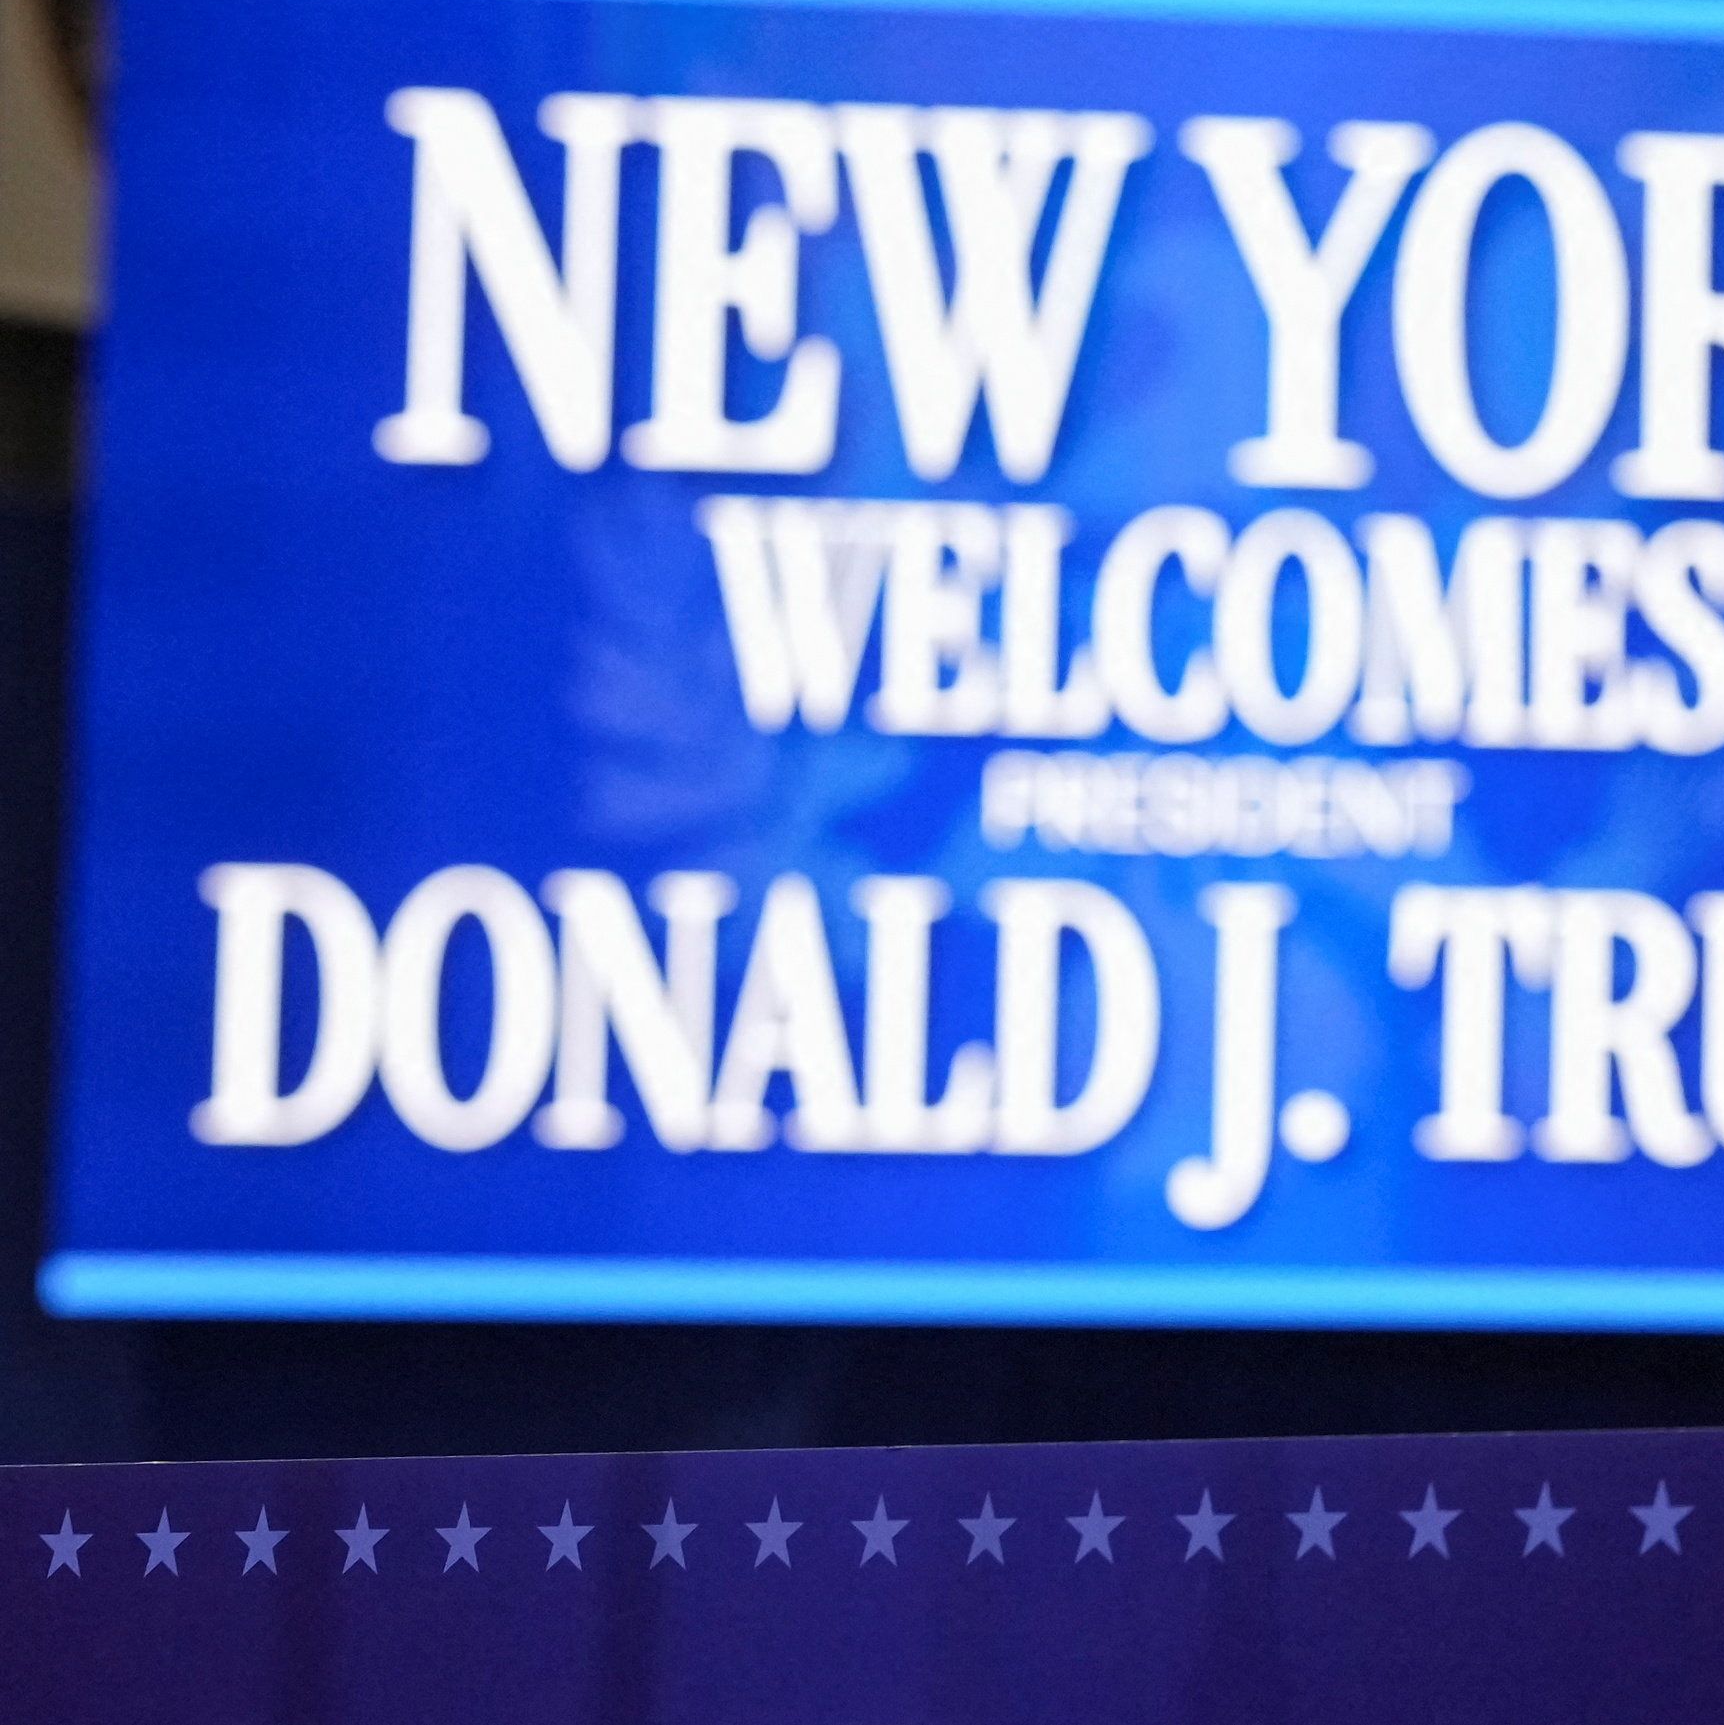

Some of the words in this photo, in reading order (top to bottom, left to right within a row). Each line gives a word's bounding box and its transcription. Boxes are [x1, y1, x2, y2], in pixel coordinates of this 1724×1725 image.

[376, 84, 1154, 482] NEW
[193, 861, 1162, 1155] DONALD
[1167, 881, 1351, 1231] J.
